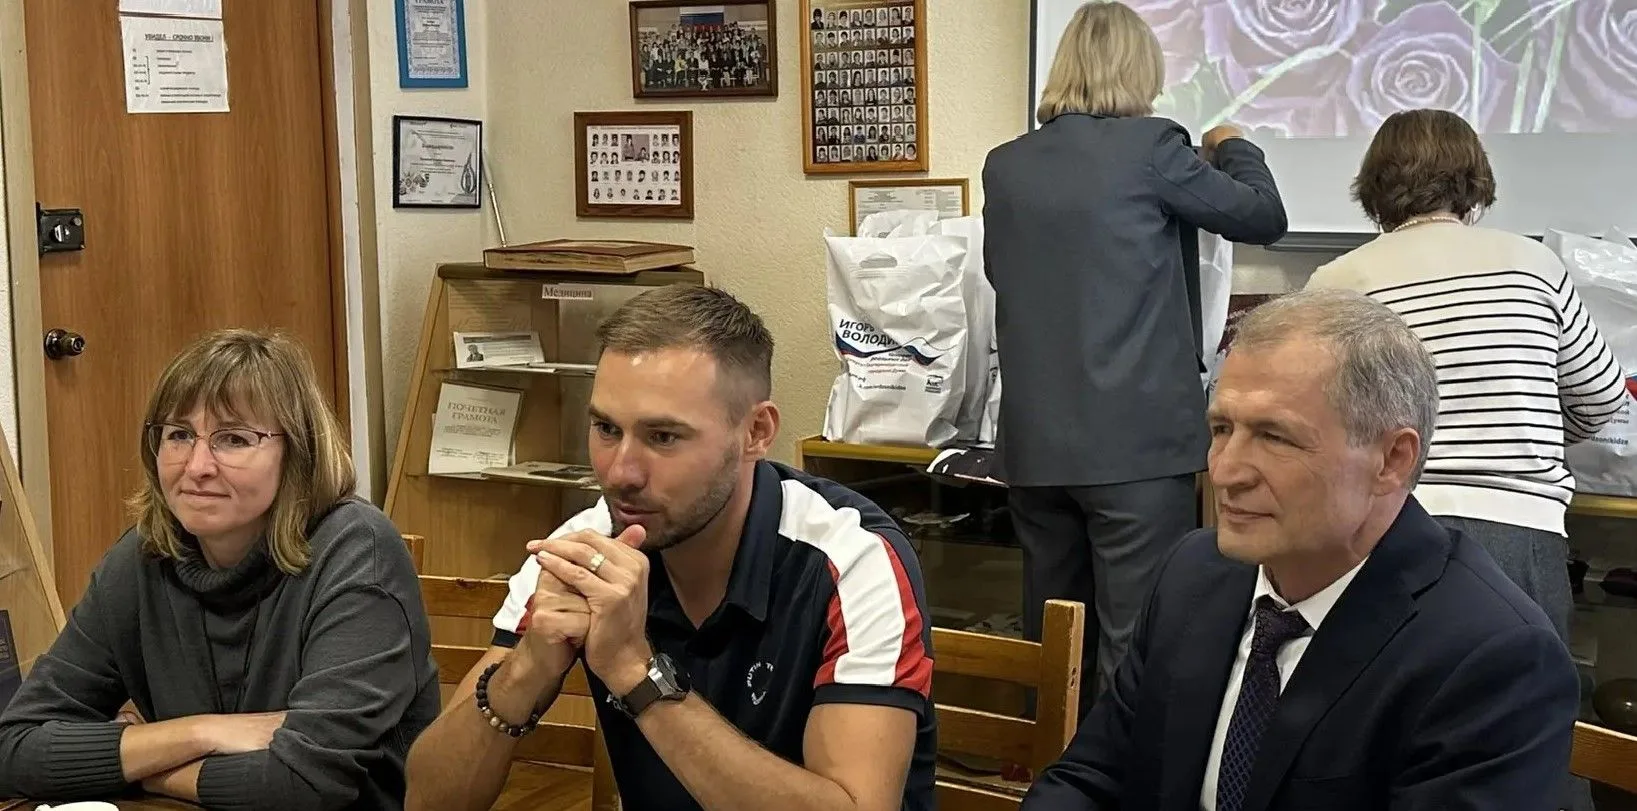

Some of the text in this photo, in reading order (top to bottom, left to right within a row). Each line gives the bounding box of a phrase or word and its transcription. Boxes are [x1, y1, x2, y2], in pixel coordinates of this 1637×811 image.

[543, 286, 592, 298] Медицина
[839, 318, 875, 332] ИГОРЬ
[842, 329, 899, 347] ВОЛОДИ
[447, 401, 506, 417] ПОЧЕТНАЯ
[452, 411, 498, 425] ГРАМОТА
